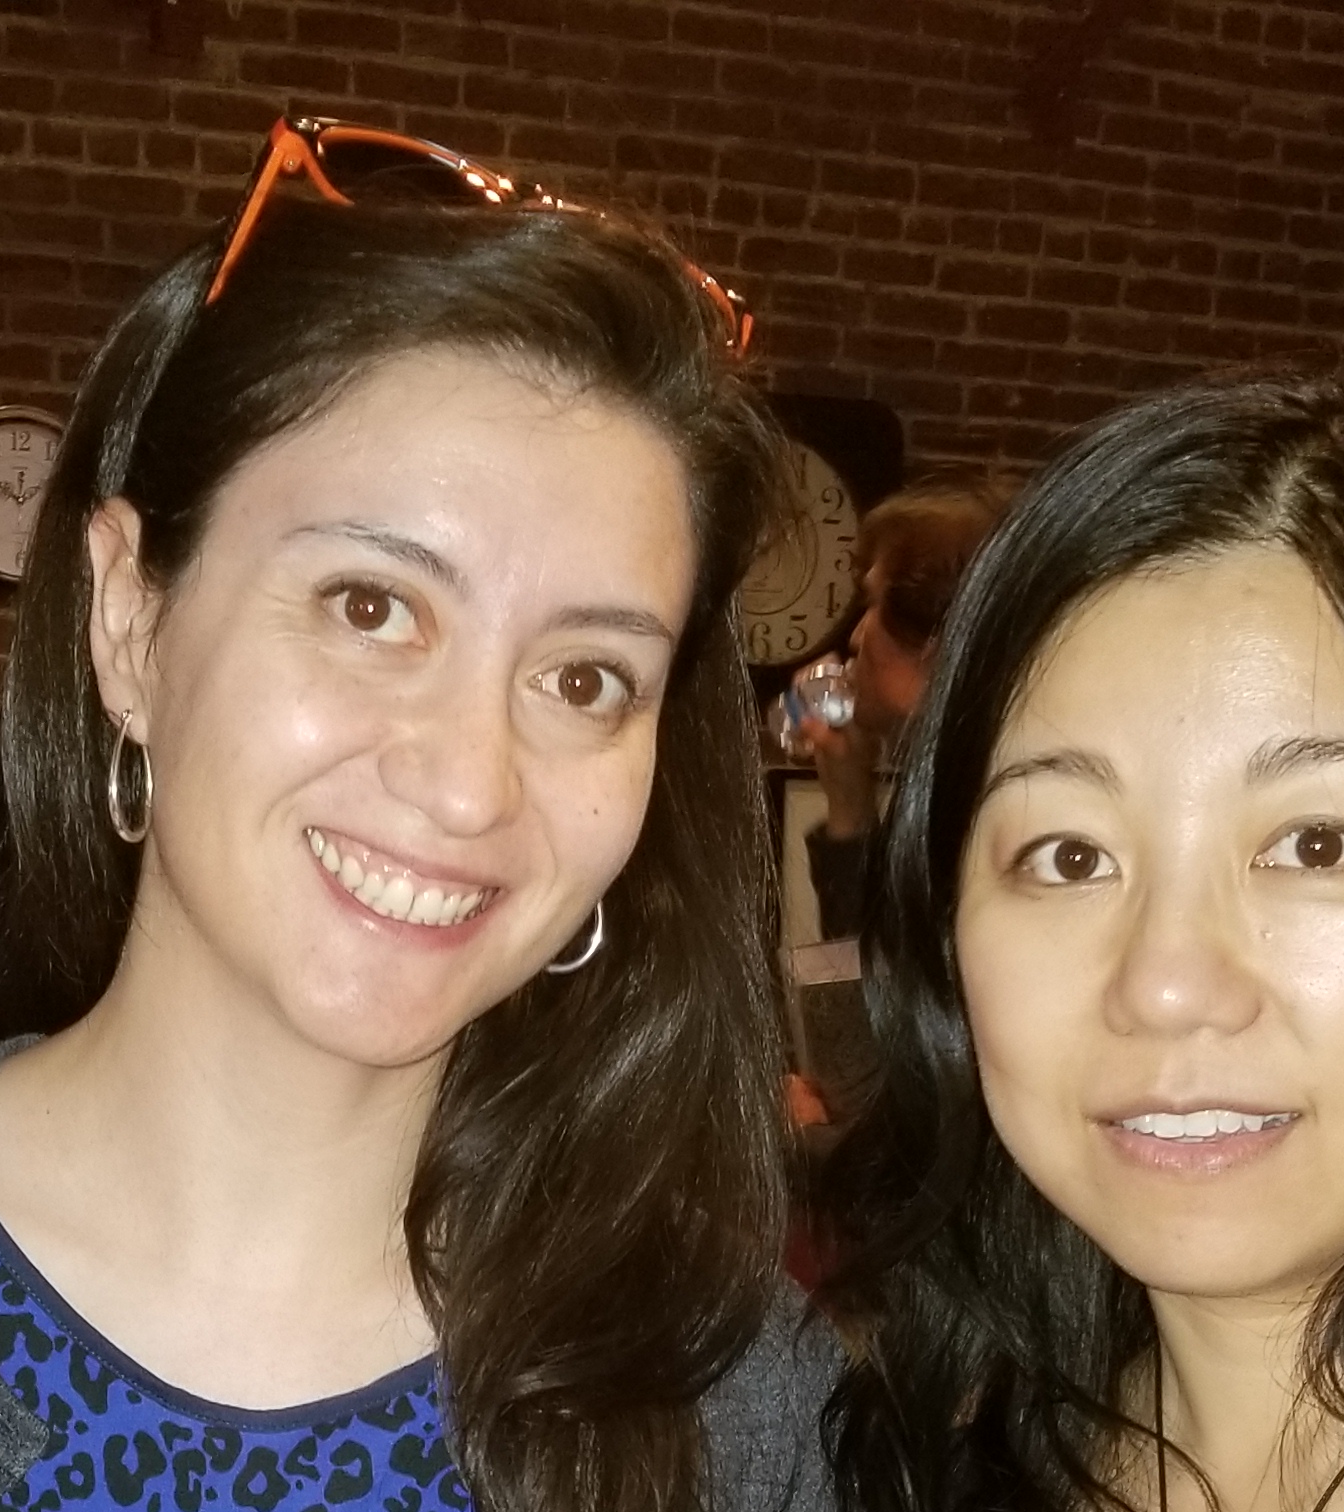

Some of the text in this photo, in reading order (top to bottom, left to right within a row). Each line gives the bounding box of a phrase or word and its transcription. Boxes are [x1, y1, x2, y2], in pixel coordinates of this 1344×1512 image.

[11, 431, 31, 451] 12
[822, 486, 844, 525] 2
[748, 622, 771, 661] 6
[786, 614, 807, 651] 5
